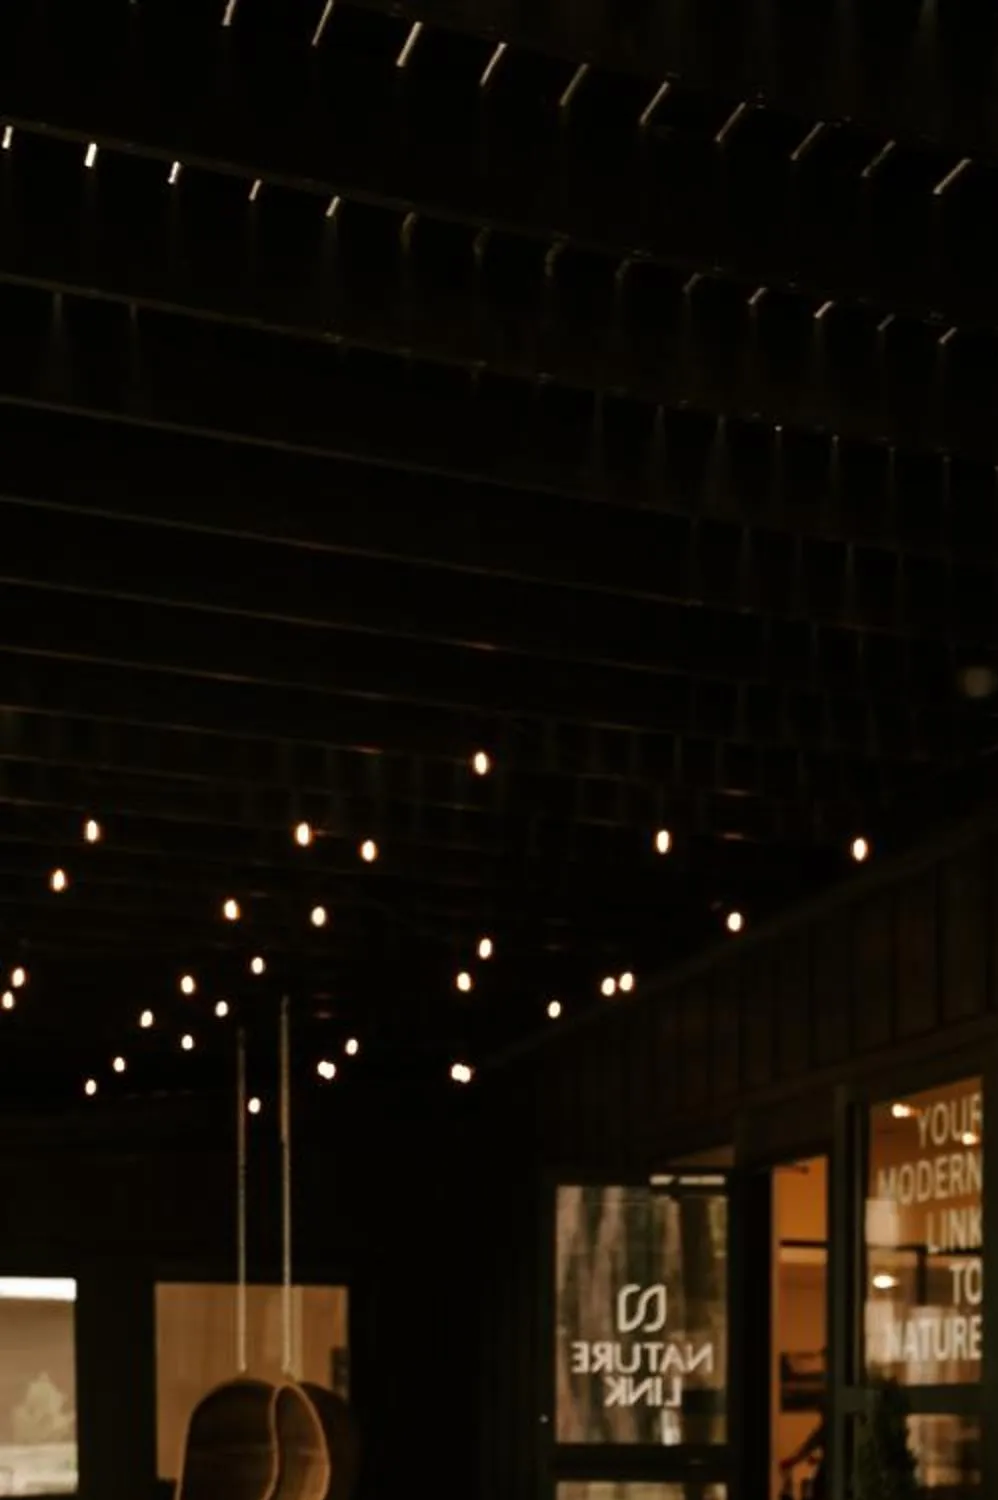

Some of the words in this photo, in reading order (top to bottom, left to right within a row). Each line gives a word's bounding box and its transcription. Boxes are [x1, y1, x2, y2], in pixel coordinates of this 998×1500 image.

[877, 1151, 982, 1207] MODERN
[926, 1206, 982, 1253] LINK
[949, 1258, 982, 1305] TO
[885, 1315, 982, 1361] NATURE
